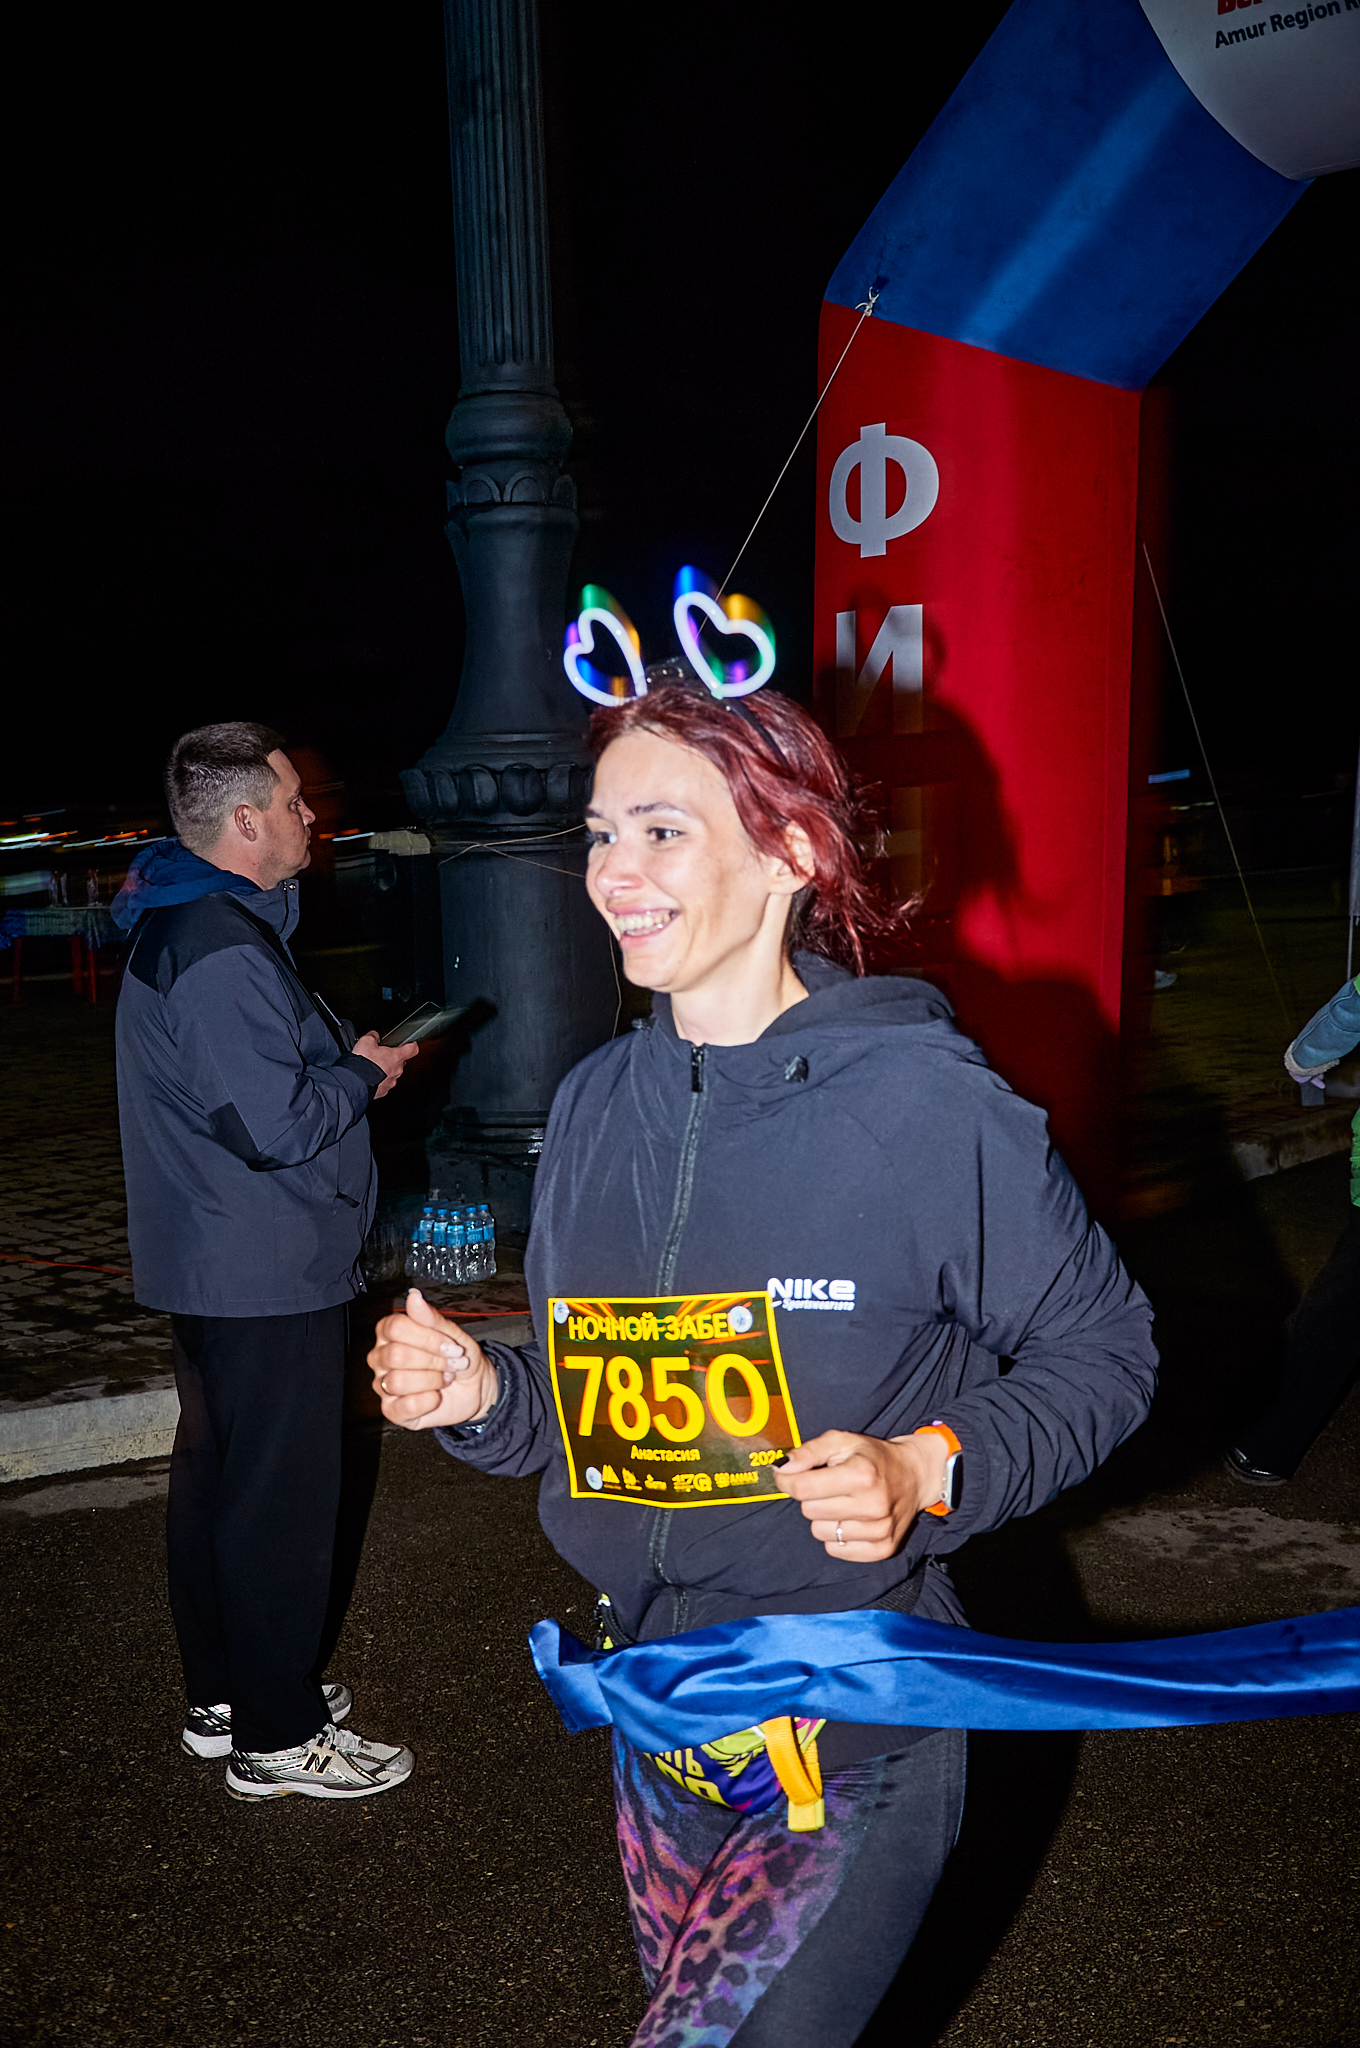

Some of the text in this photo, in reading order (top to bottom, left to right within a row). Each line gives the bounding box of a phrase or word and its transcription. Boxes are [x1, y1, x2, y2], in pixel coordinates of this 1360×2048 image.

[1216, 22, 1266, 48] Amur
[1270, 1, 1341, 32] Region
[567, 1311, 660, 1341] НОЧНОЙ
[563, 1353, 770, 1442] 7850
[630, 1445, 701, 1462] Анастасия
